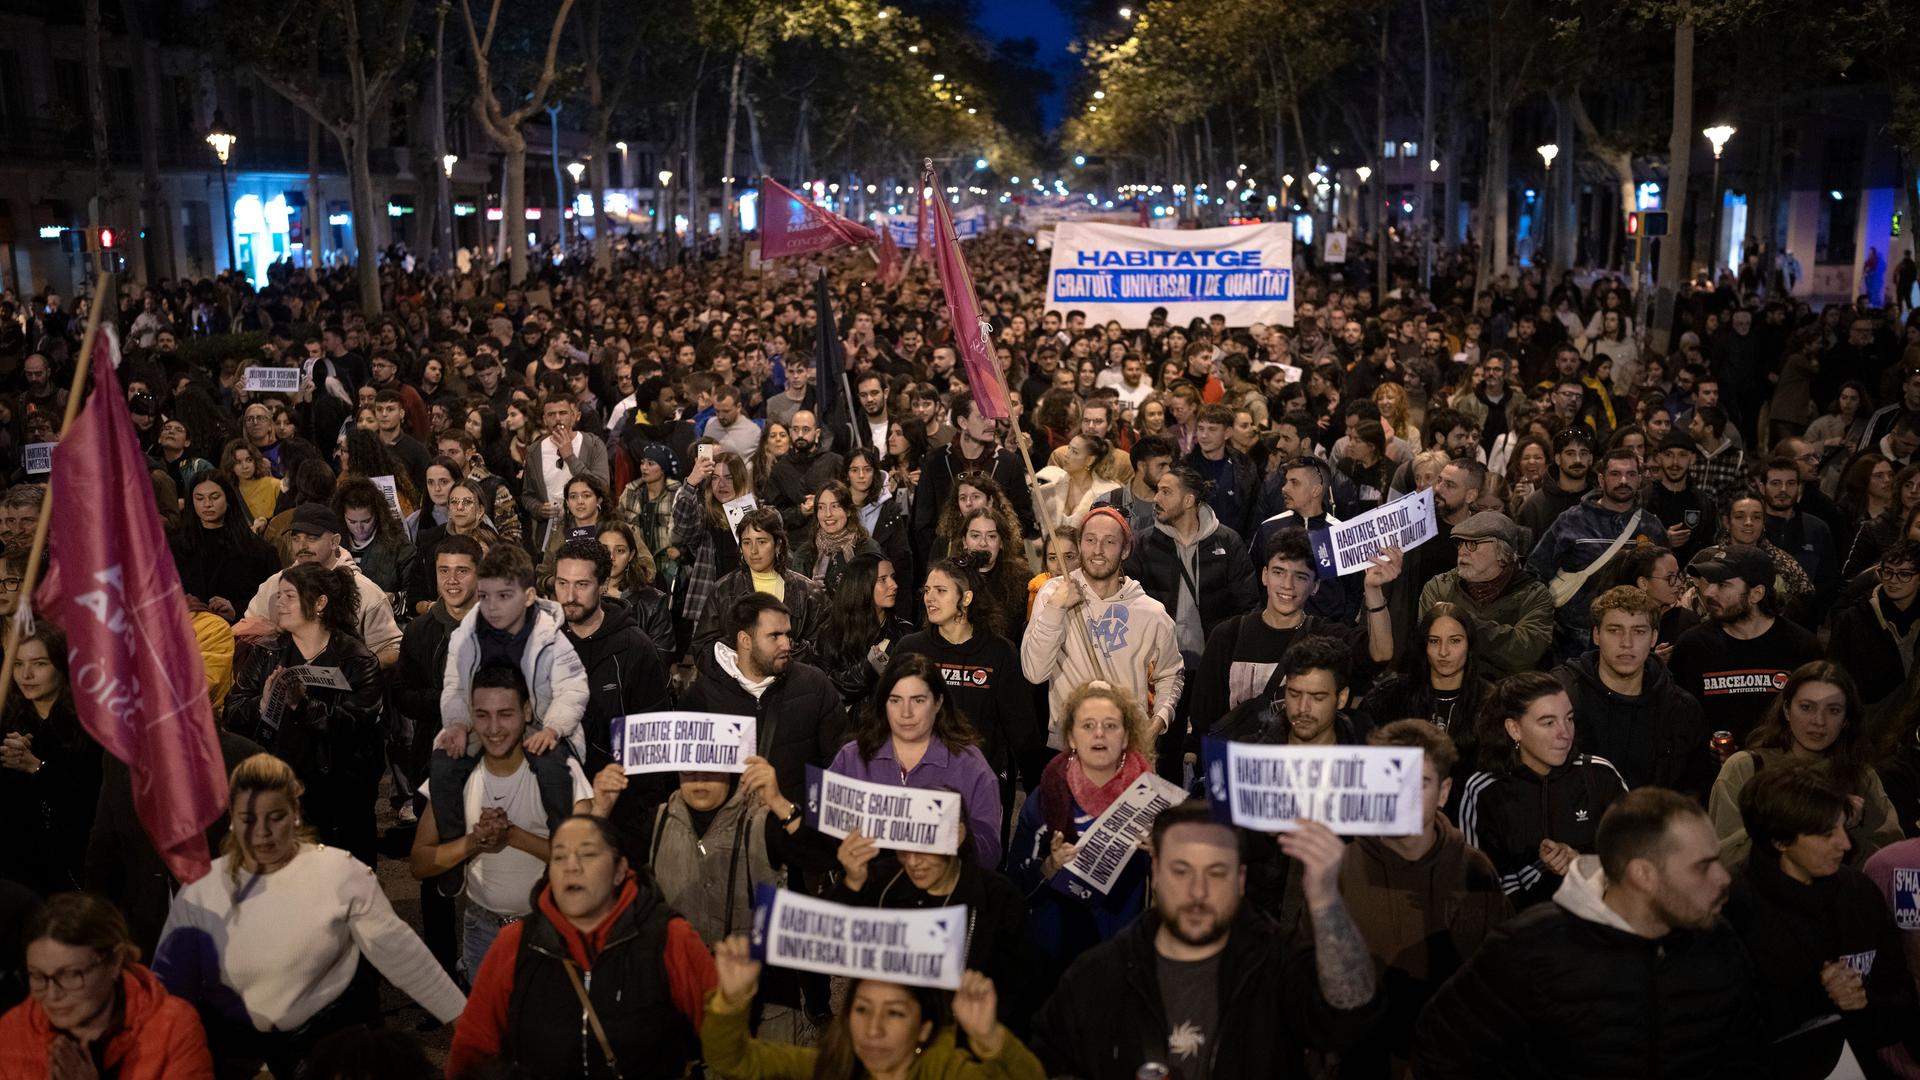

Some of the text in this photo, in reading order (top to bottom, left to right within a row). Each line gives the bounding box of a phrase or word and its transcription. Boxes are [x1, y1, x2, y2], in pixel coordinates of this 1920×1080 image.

[1077, 250, 1262, 266] HABITATGE
[1121, 273, 1193, 298] UNIVERSAL
[1196, 273, 1201, 297] I
[1204, 273, 1221, 297] DE
[1224, 271, 1288, 297] QUALITAT
[1335, 519, 1378, 550] HABITATGE
[1400, 518, 1427, 548] QUALITAT
[941, 668, 970, 681] VAL
[1703, 674, 1772, 690] BARCELONA
[629, 720, 673, 744] HABITATGE
[674, 718, 715, 742] GRATUÏT,
[629, 743, 740, 766] UNIVERSAL I DE QUALITAT
[1235, 756, 1303, 788] HABITATE
[827, 780, 866, 813] HABITATGE
[868, 792, 912, 819] GRATUÏT,
[1339, 793, 1399, 823] QUALITAT
[866, 817, 872, 838] I
[874, 818, 886, 840] DE
[889, 820, 939, 846] QUALITAT
[1090, 793, 1172, 886] UNIVERSAL I DE QUALITAT
[1072, 828, 1113, 875] HABITATGE
[780, 903, 845, 941] HABITATGE
[777, 934, 946, 978] UNIVERSAL I DE QUALITAT
